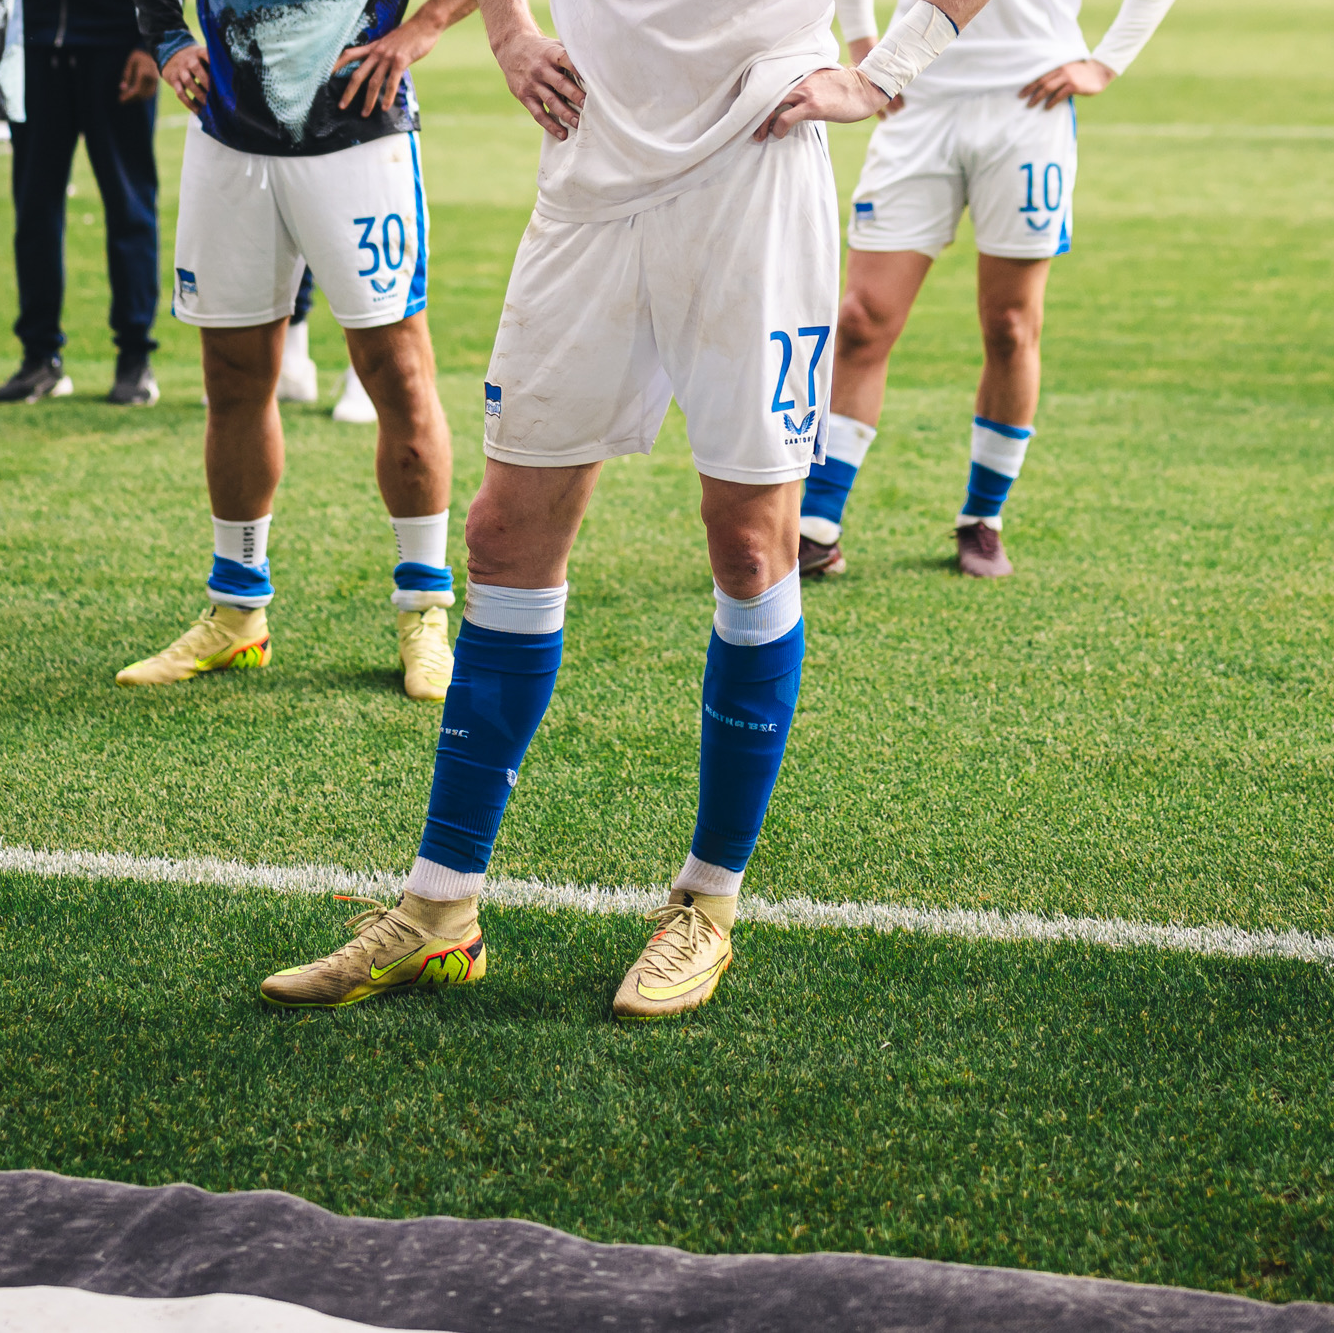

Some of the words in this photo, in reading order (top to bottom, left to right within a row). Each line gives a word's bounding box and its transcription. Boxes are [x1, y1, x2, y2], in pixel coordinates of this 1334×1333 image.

[1019, 162, 1063, 213] 10
[353, 213, 405, 277] 30
[770, 325, 831, 413] 27
